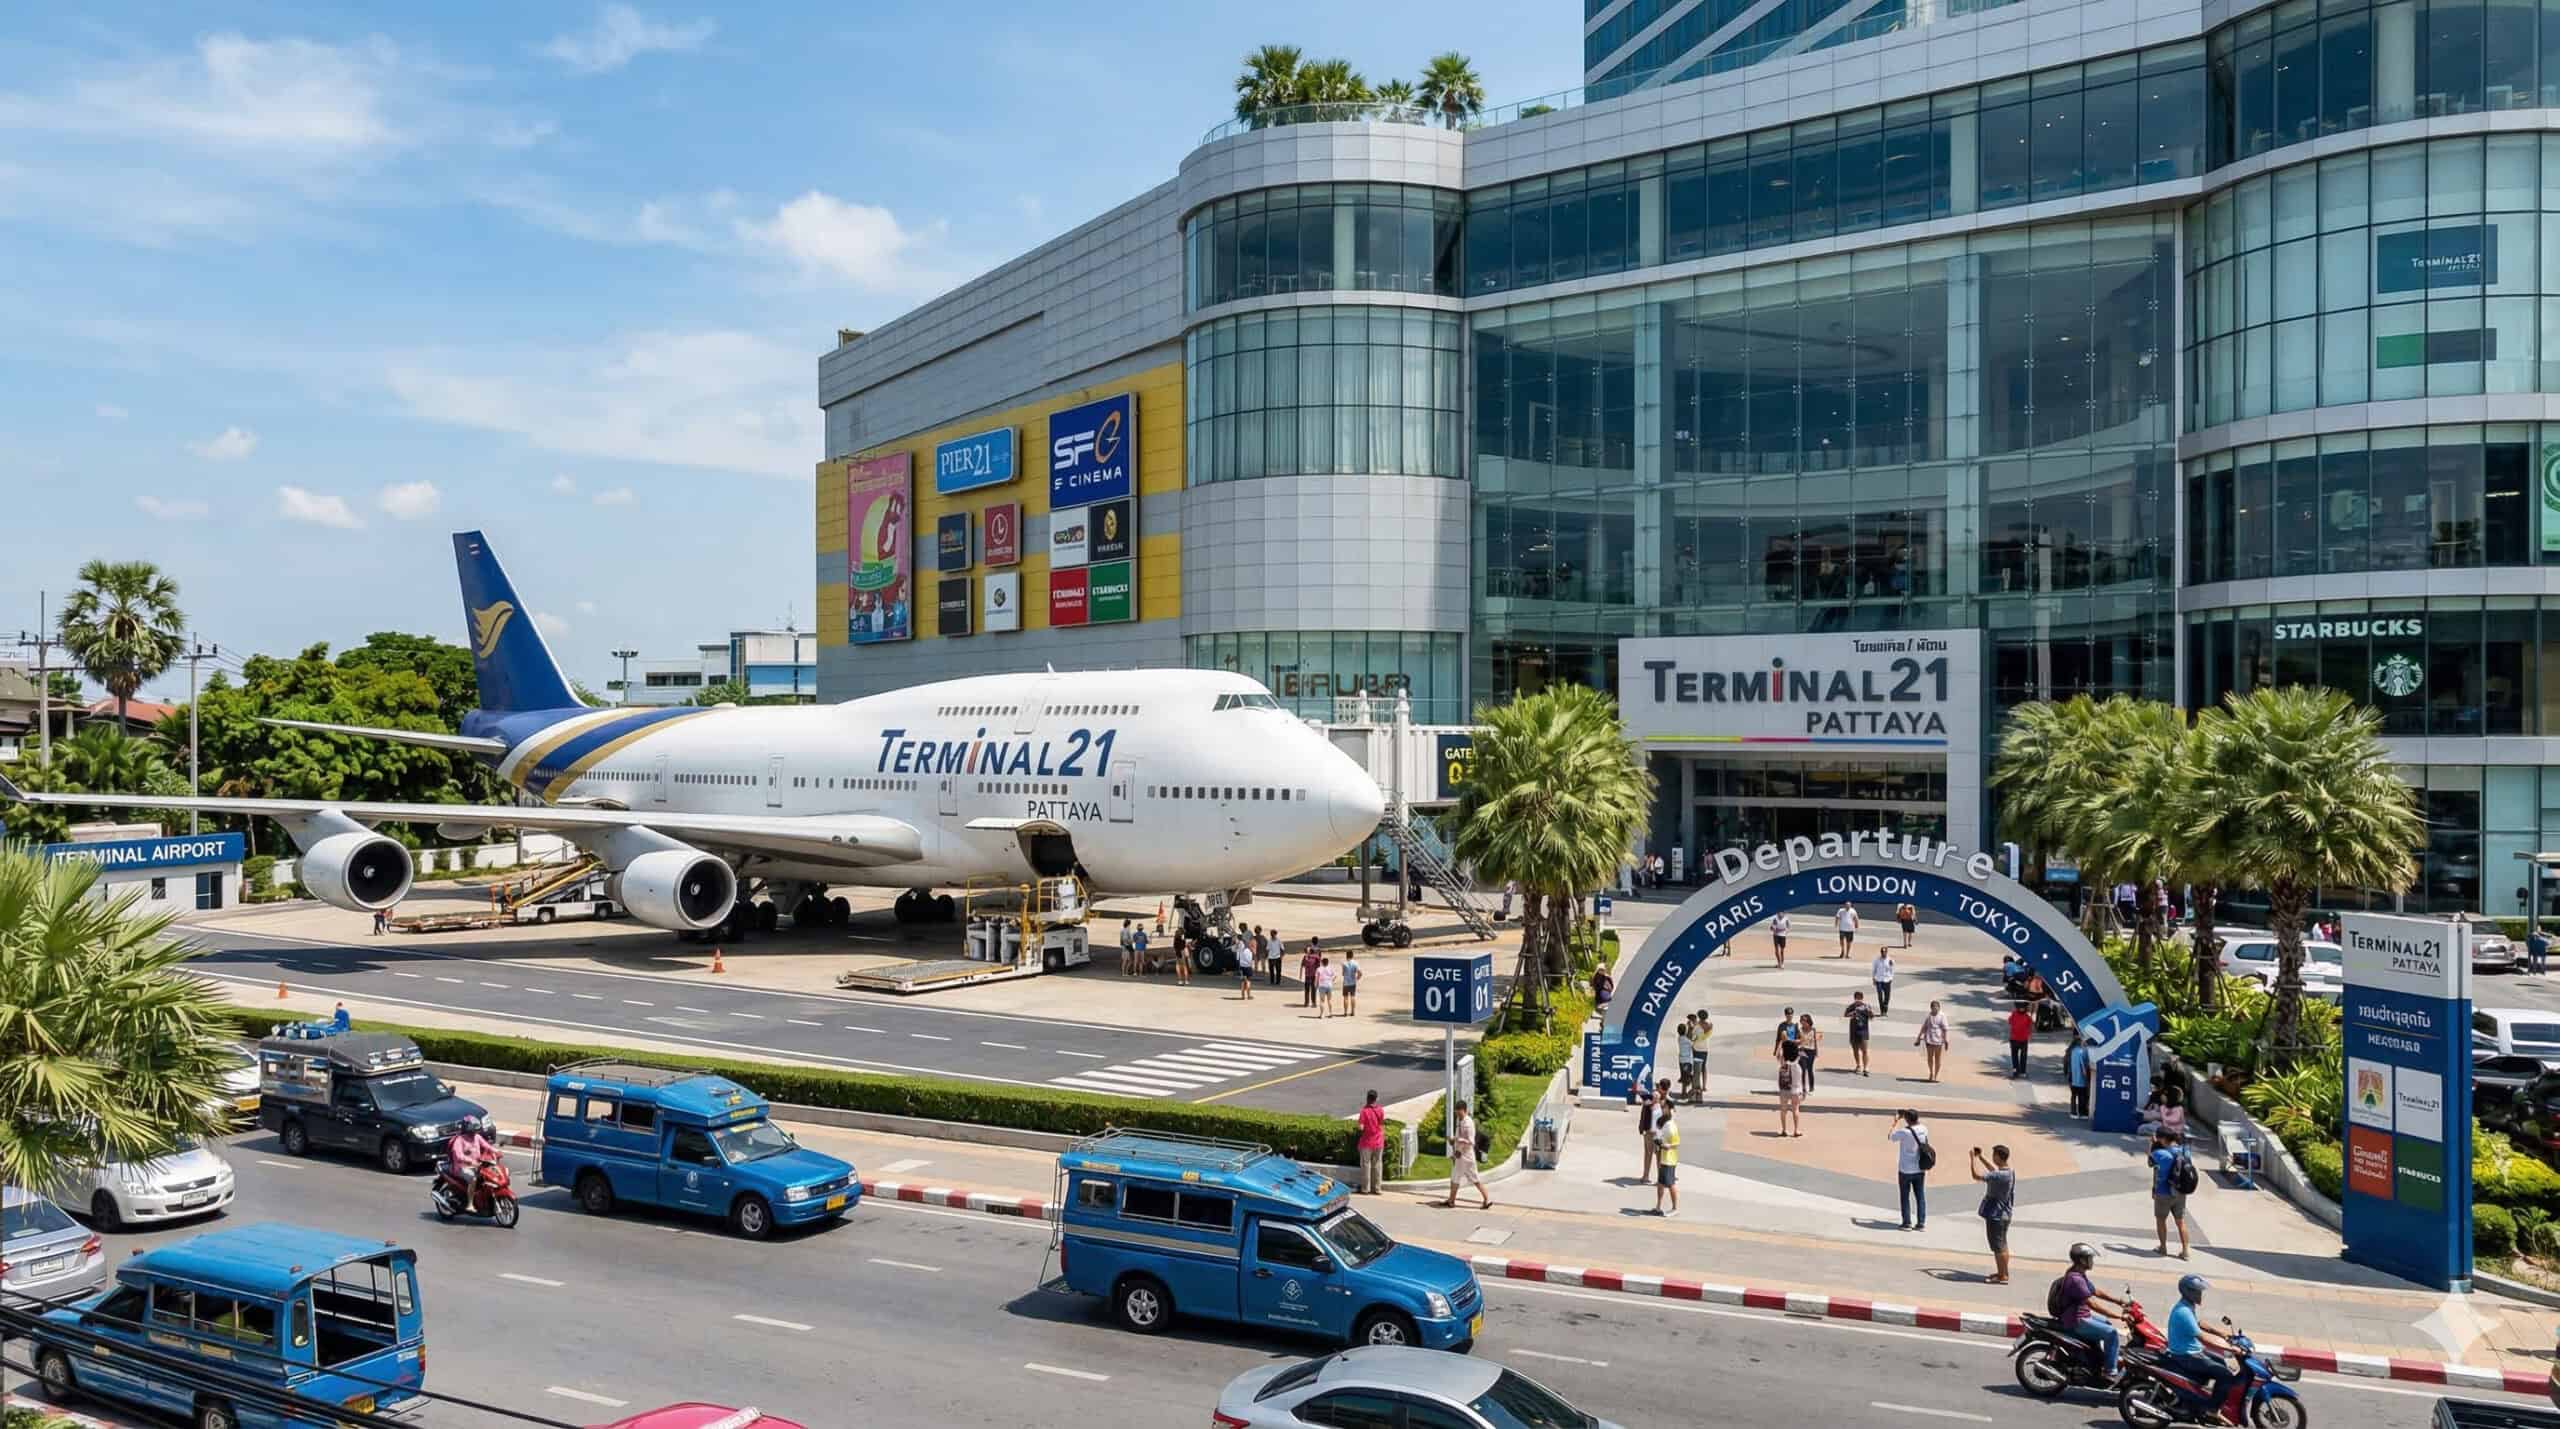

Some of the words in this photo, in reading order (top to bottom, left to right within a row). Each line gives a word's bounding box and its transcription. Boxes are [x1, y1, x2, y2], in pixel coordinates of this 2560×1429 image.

[1070, 466, 1122, 487] CINEMA
[2275, 619, 2423, 640] STARBUCKS
[1806, 711, 1947, 735] PATTAYA
[1445, 748, 1474, 760] GATE
[1028, 801, 1103, 821] PATTAYA
[152, 841, 226, 861] AIRPORT
[1714, 826, 1995, 885] Departure
[1641, 961, 1683, 1016] PARIS
[1705, 896, 1764, 939] PARIS
[1817, 875, 1916, 896] LONDON
[1960, 894, 2030, 944] TOKYO
[2056, 970, 2083, 993] SF
[1423, 968, 1462, 982] GATE
[2393, 956, 2440, 974] PATTAYA
[1425, 986, 1456, 1013] 01
[1475, 983, 1489, 1012] 01
